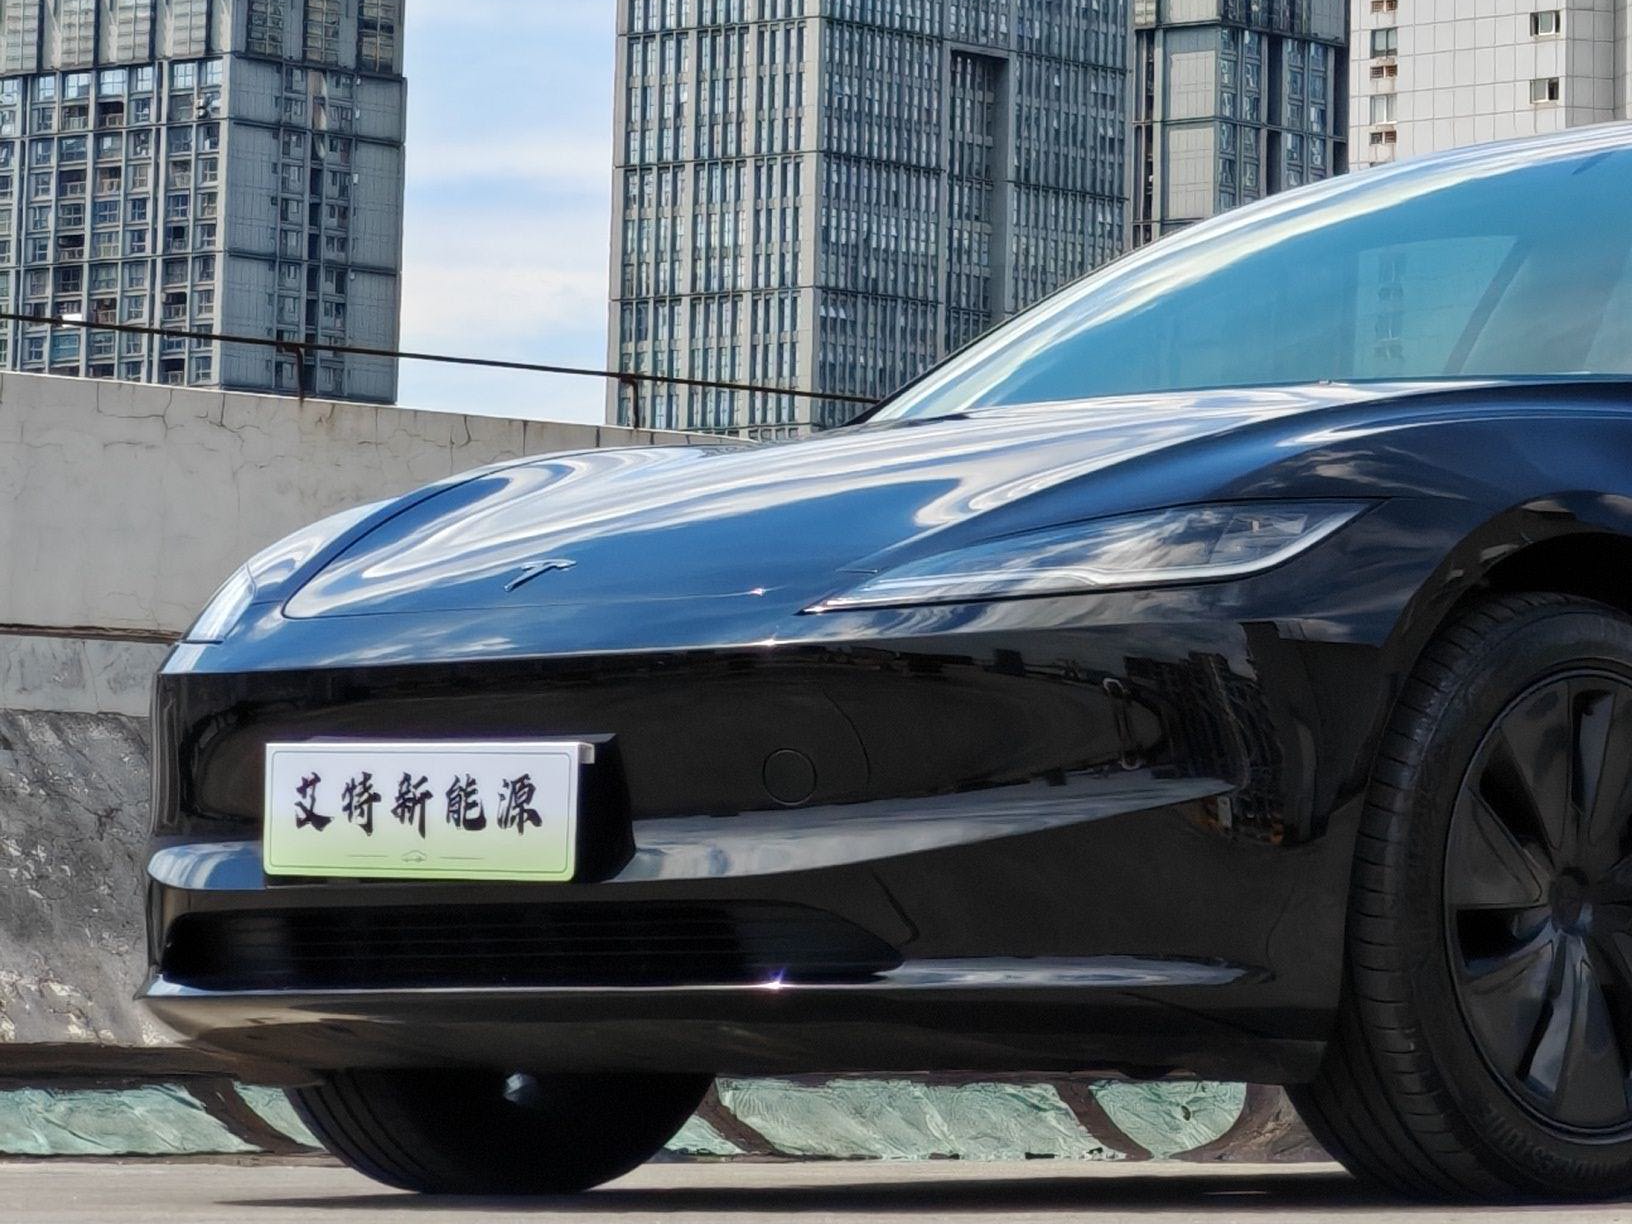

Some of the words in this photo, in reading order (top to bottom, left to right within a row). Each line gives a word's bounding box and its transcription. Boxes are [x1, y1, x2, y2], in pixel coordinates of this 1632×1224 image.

[294, 772, 544, 839] 艾特新能源
